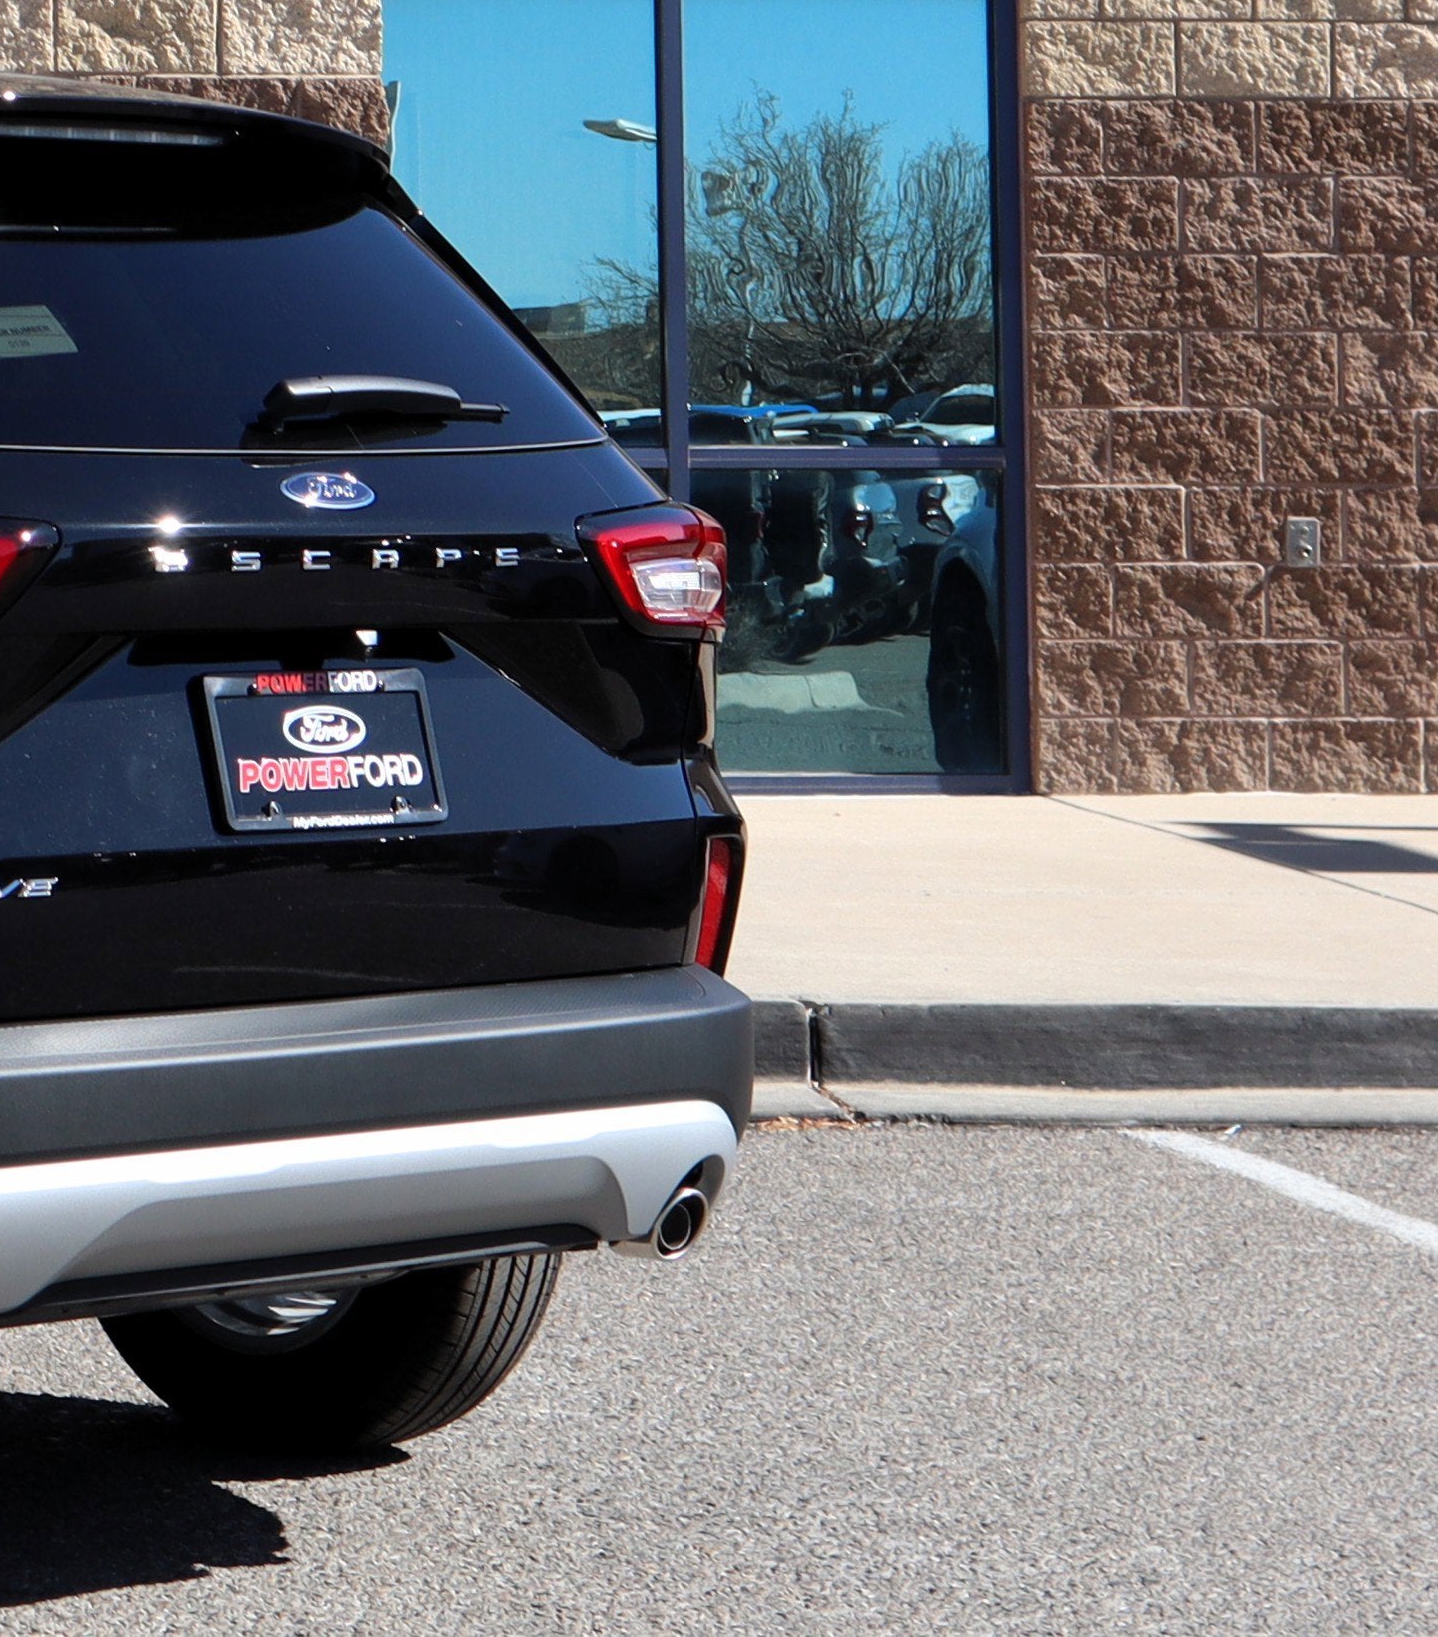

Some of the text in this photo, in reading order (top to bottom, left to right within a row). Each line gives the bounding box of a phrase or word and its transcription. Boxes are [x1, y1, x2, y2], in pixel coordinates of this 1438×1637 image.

[306, 474, 358, 499] Ford
[299, 713, 350, 744] Ford
[236, 753, 424, 794] POWERFORD
[292, 813, 395, 830] MyFordDealer.com
